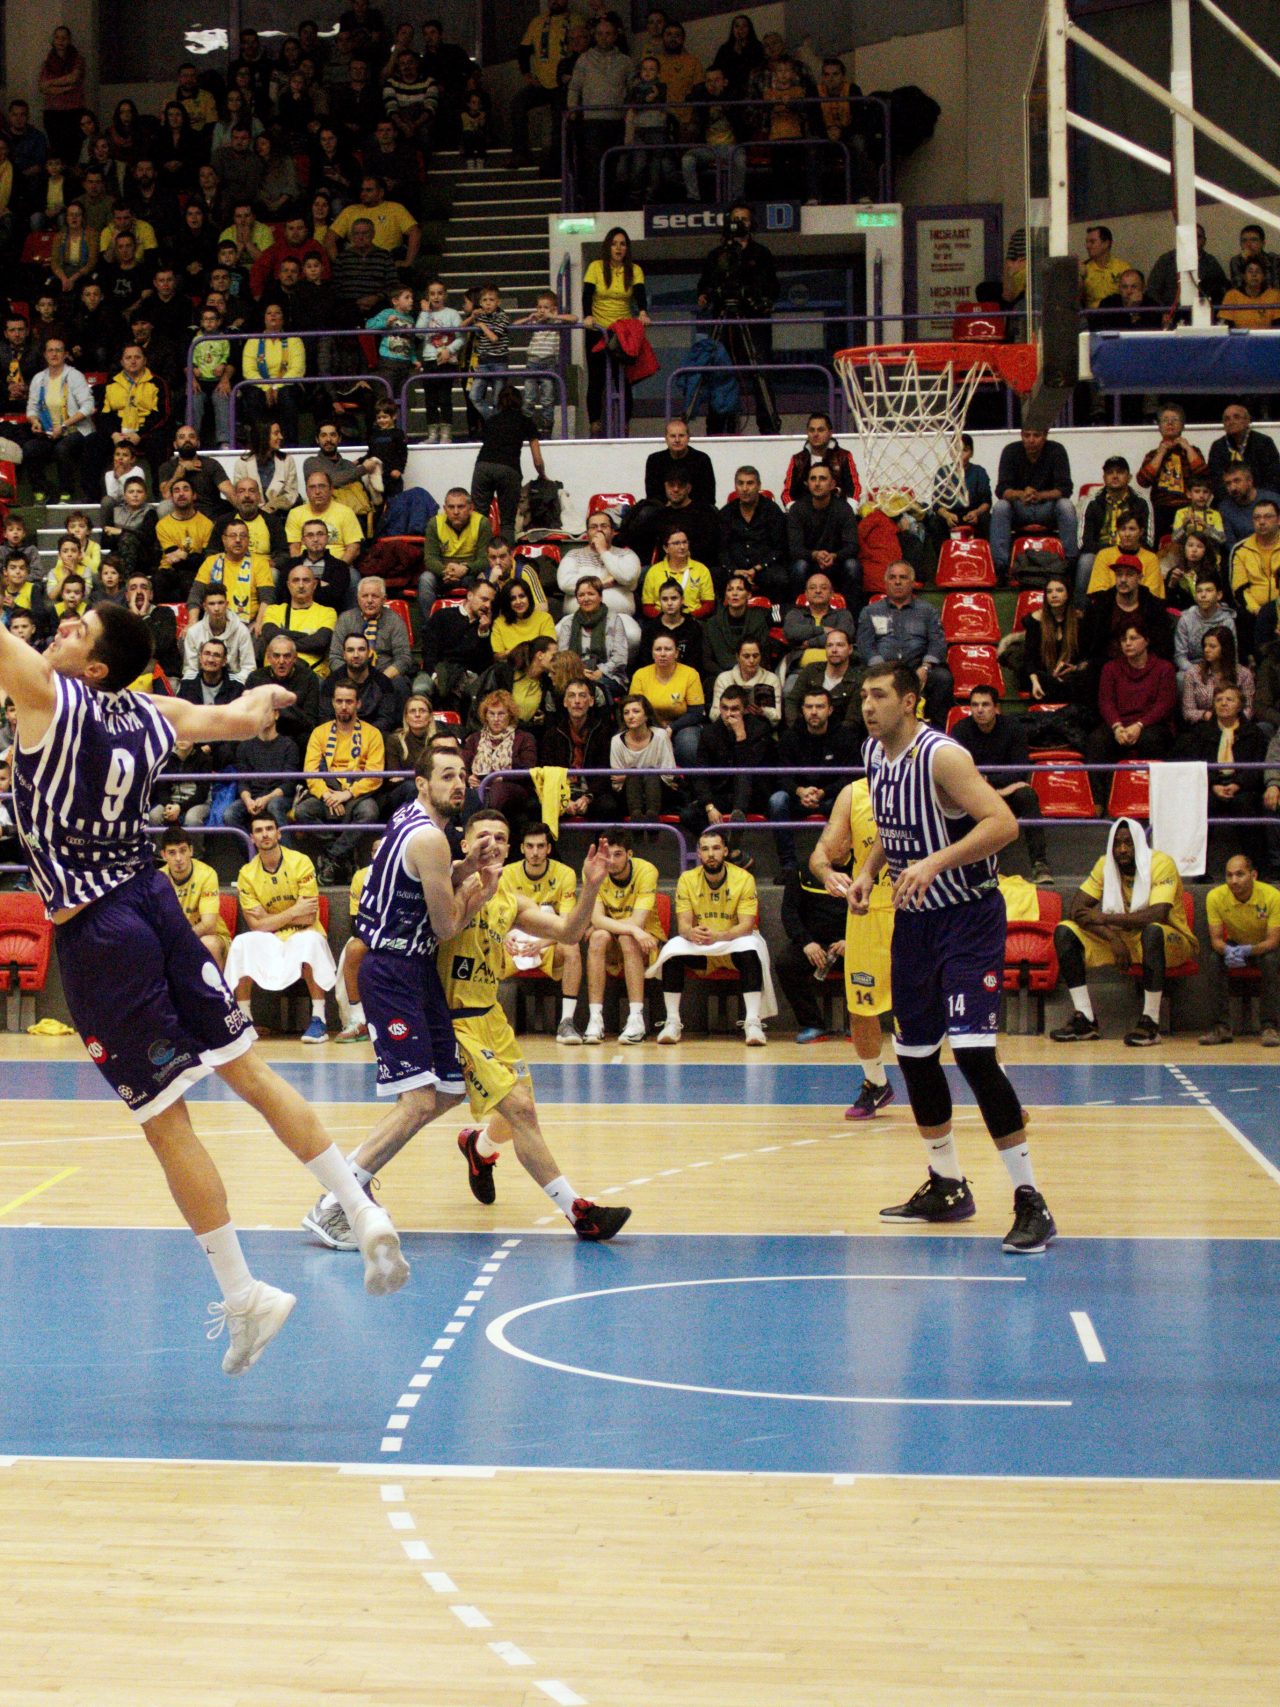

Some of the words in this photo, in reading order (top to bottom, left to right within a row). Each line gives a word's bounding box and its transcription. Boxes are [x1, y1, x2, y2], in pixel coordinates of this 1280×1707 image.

[652, 211, 725, 228] sect
[766, 203, 794, 230] D
[101, 747, 136, 822] 9
[880, 784, 895, 815] 14
[855, 990, 875, 1006] 14
[947, 993, 967, 1018] 14
